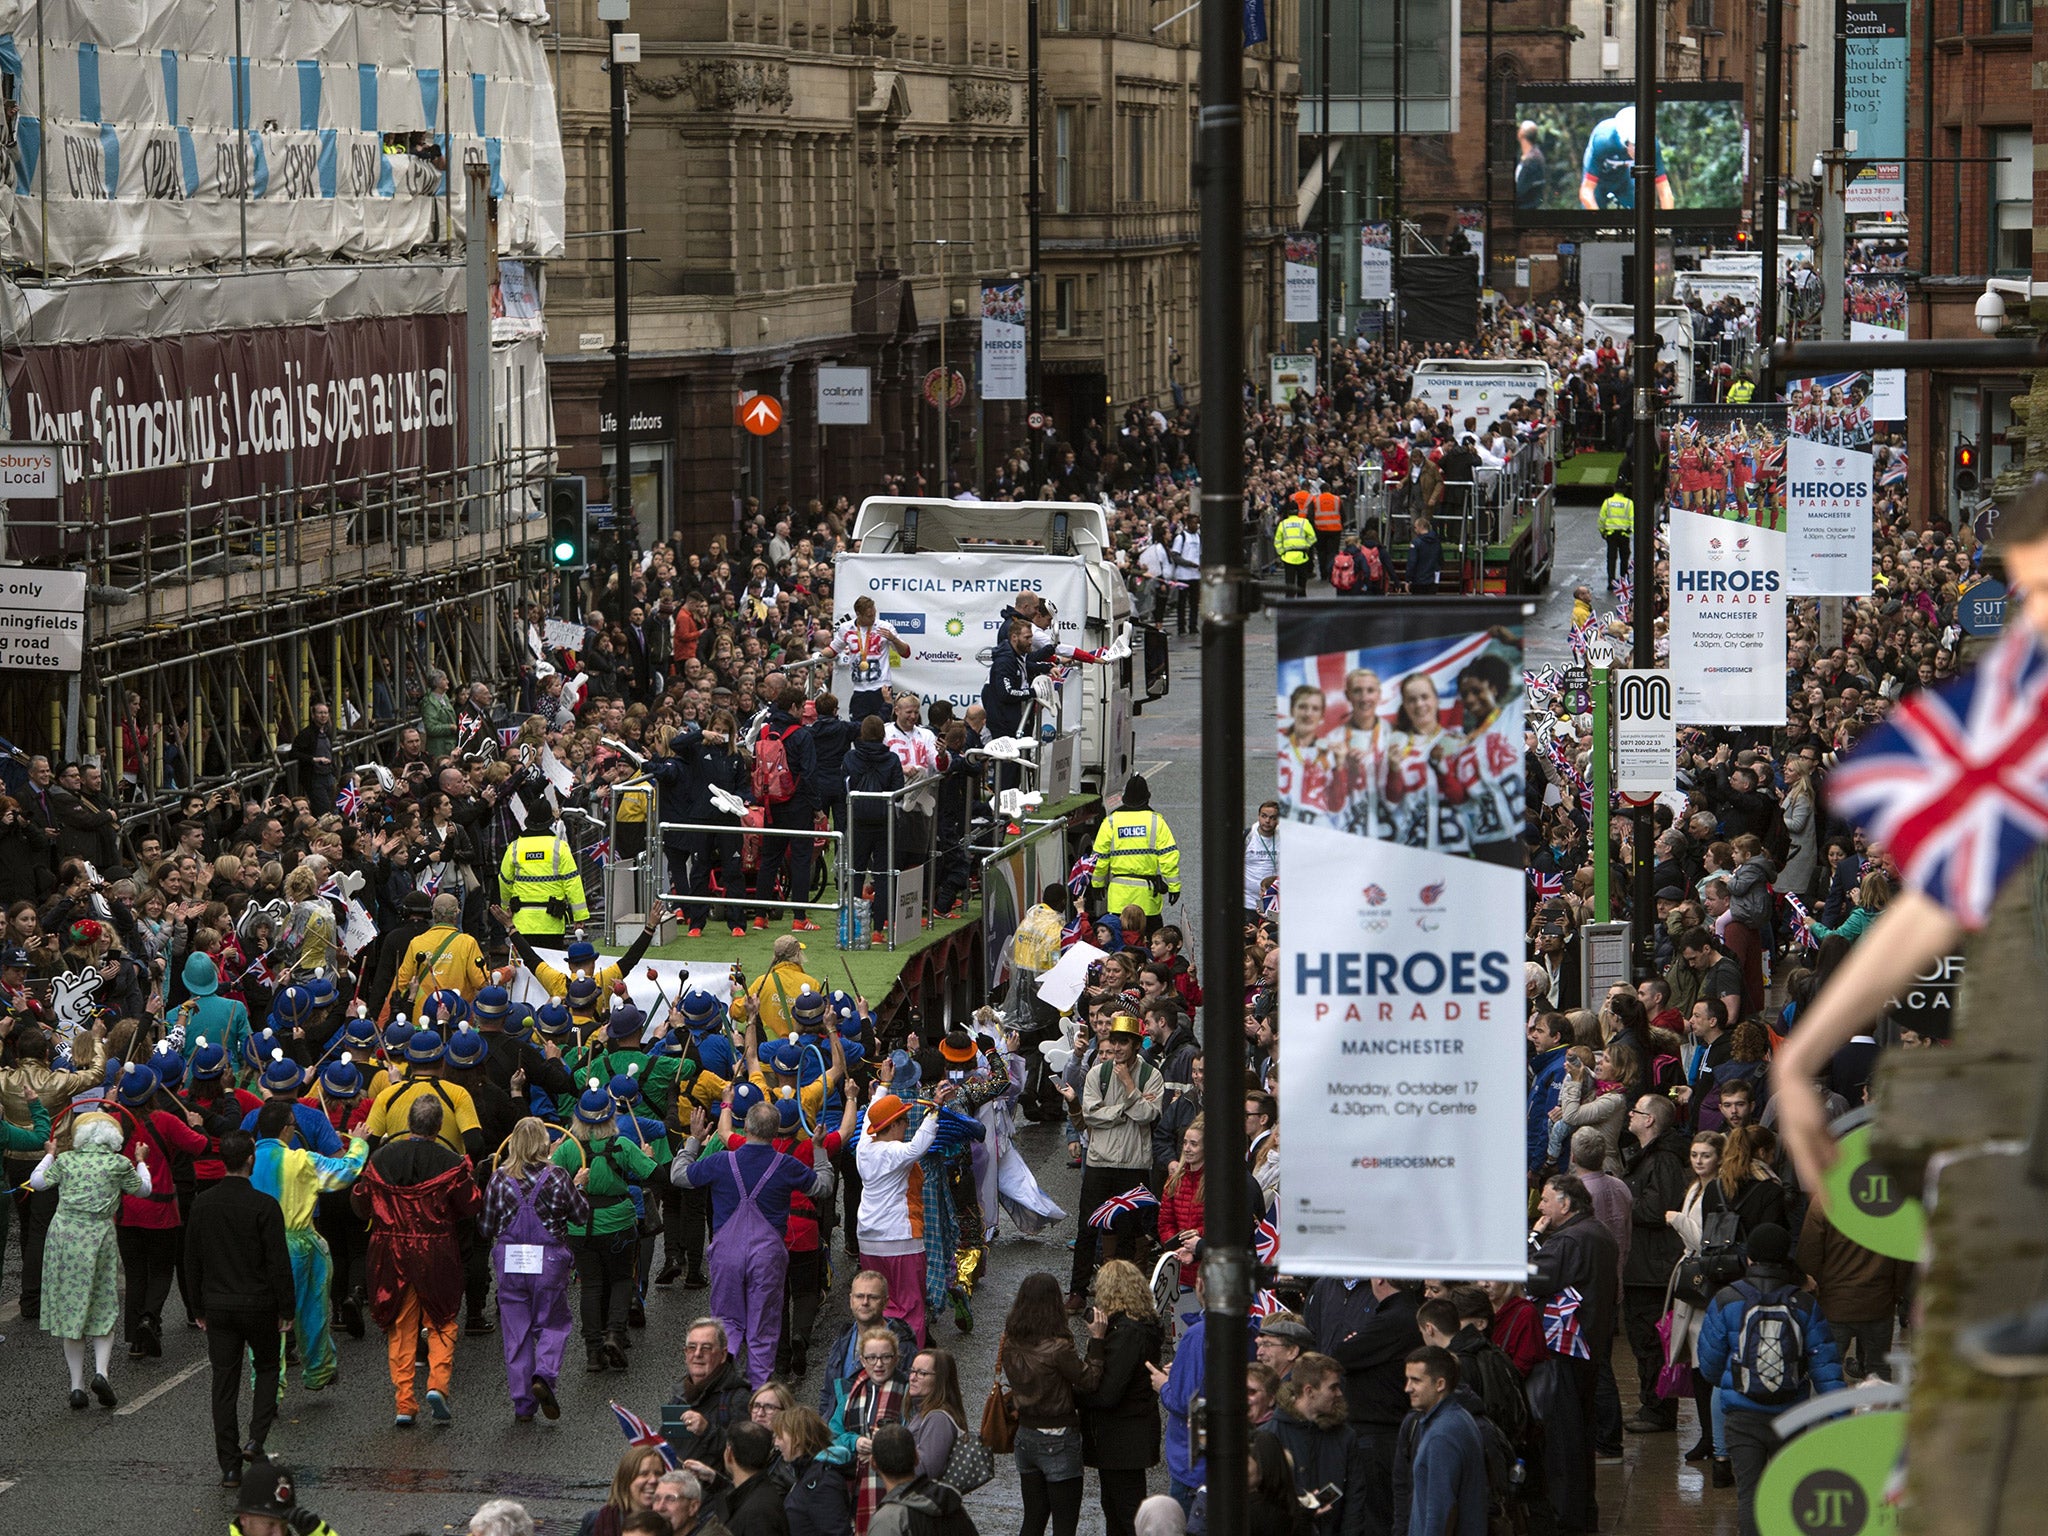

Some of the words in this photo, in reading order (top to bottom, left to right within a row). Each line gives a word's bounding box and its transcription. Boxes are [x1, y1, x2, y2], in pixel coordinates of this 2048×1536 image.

[1846, 11, 1878, 21] South
[1846, 24, 1887, 34] Central
[1872, 73, 1887, 84] be
[1846, 88, 1880, 97] about
[1854, 103, 1866, 112] to
[985, 341, 1023, 349] HEROES
[90, 372, 231, 490] Sainsbury's
[232, 372, 295, 455] Local
[296, 360, 322, 448] is
[324, 376, 369, 465] open
[600, 412, 617, 432] Life
[629, 411, 662, 430] tdoors
[4, 471, 45, 484] Local
[1791, 482, 1867, 498] HEROES
[869, 578, 946, 592] OFFICIAL
[952, 579, 1042, 592] PARTNERS
[1677, 570, 1780, 592] HEROES
[9, 582, 43, 597] only
[1686, 594, 1771, 604] PARADE
[1699, 612, 1758, 620] MANCHESTER
[1692, 631, 1723, 640] Monday,
[1725, 631, 1755, 639] October
[1757, 631, 1764, 639] 17
[14, 637, 49, 649] road
[1724, 641, 1738, 650] City
[1739, 641, 1764, 649] Centre
[9, 653, 59, 666] routes
[1569, 681, 1584, 689] BUS
[1118, 826, 1146, 837] POLICE
[1296, 951, 1510, 995] HEROES
[1315, 1001, 1491, 1022] PARADE
[1341, 1039, 1464, 1055] MANCHESTER
[1327, 1081, 1393, 1097] Monday,
[1396, 1081, 1459, 1096] October
[1463, 1081, 1479, 1095] 17
[1330, 1102, 1390, 1118] 4.30pm,
[1394, 1102, 1424, 1117] City
[1427, 1102, 1477, 1115] Centre
[1351, 1156, 1456, 1169] #GBHEROESMCR
